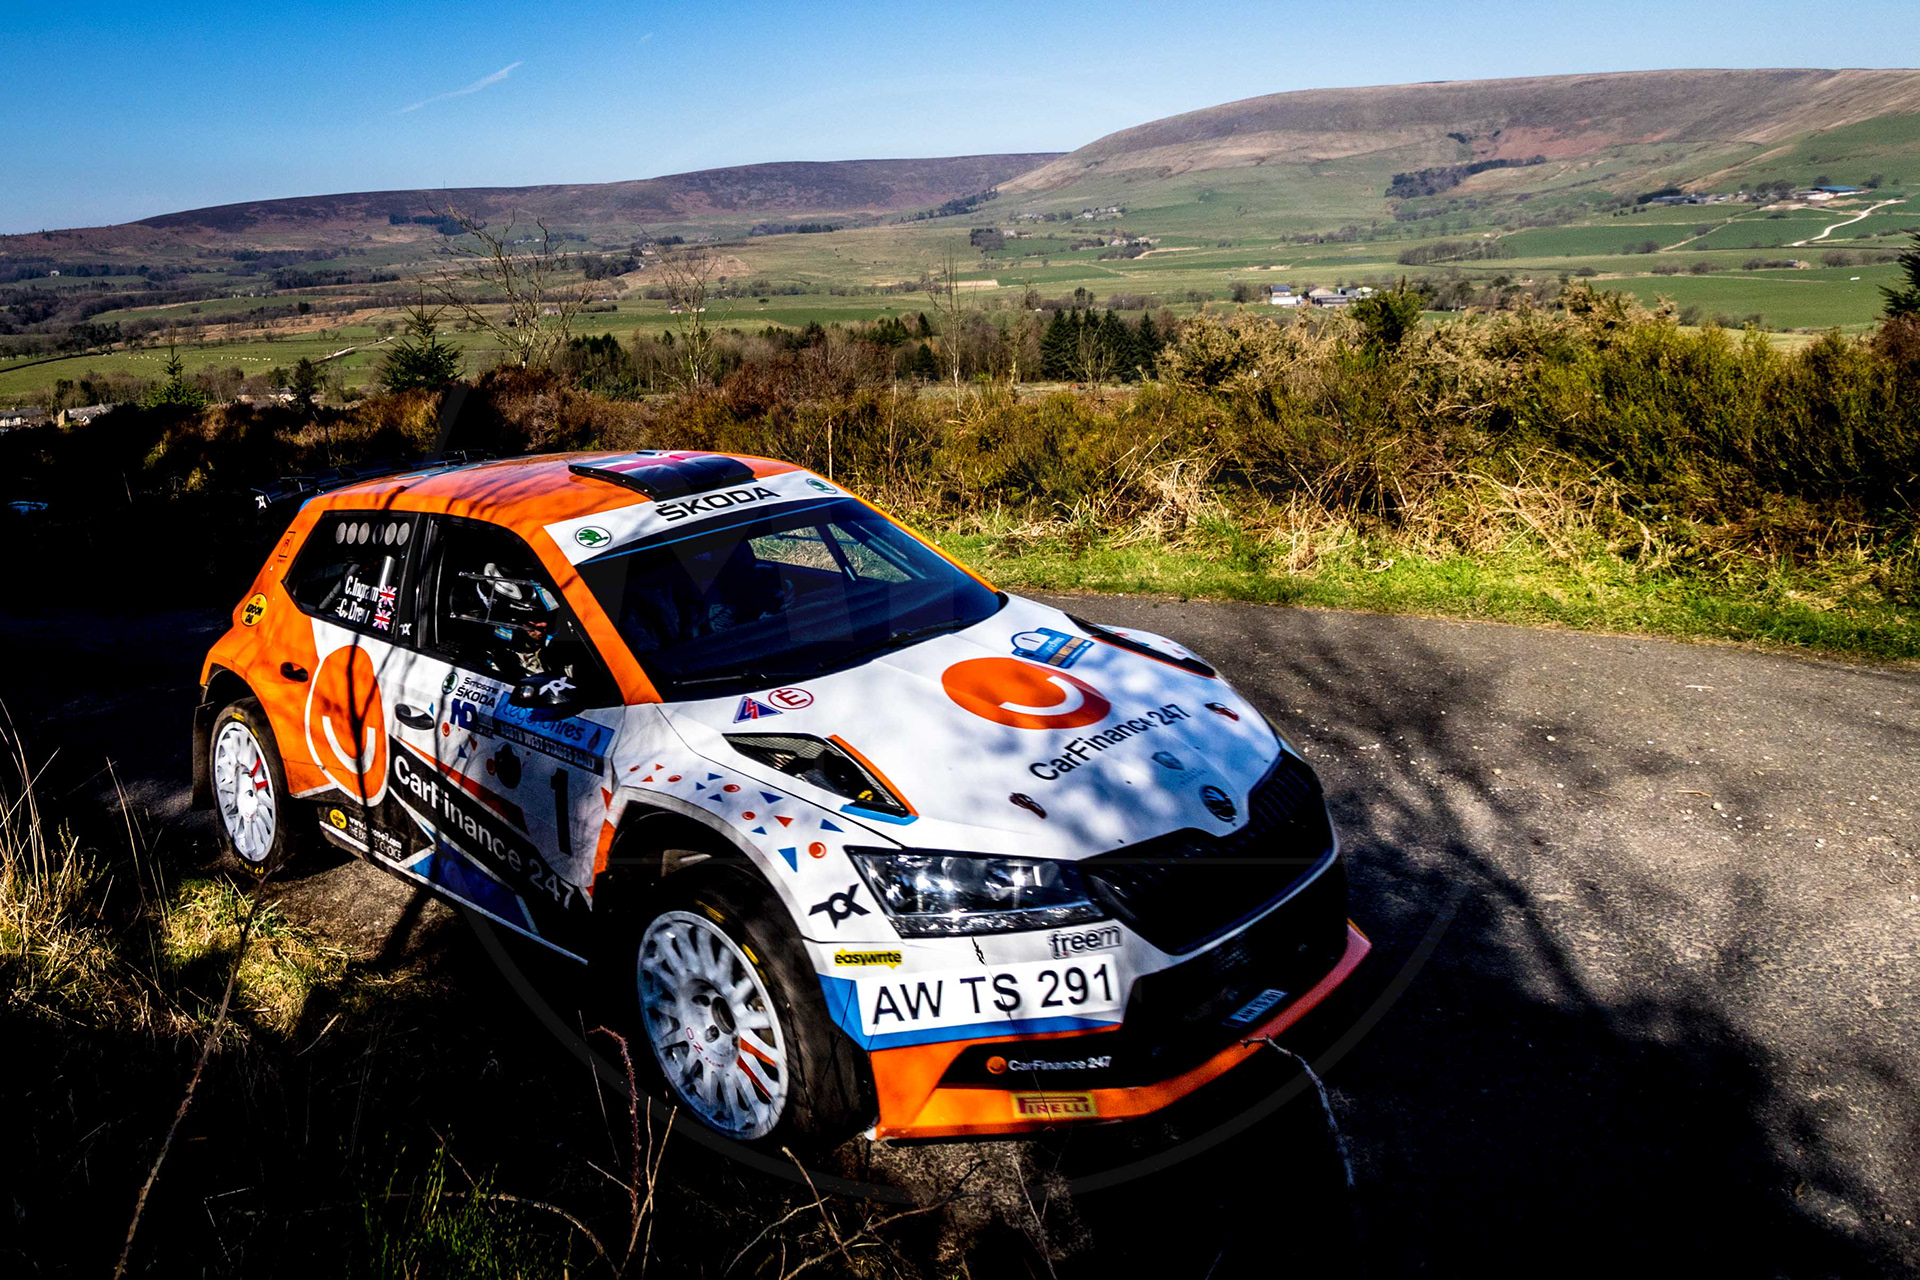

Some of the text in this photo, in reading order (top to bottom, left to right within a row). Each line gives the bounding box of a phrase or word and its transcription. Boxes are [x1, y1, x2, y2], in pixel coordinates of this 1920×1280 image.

[655, 487, 781, 521] ŠKODA
[455, 684, 496, 708] ŠKODA
[464, 677, 499, 694] Simpsons
[1029, 717, 1158, 780] CarFinance
[1147, 703, 1191, 725] 247
[393, 755, 575, 911] CarFinance 247
[1049, 927, 1121, 957] freem
[872, 963, 1113, 1024] AW TS 291
[1008, 1055, 1112, 1071] CarFinance 247
[1017, 1096, 1091, 1114] PIRELLI
